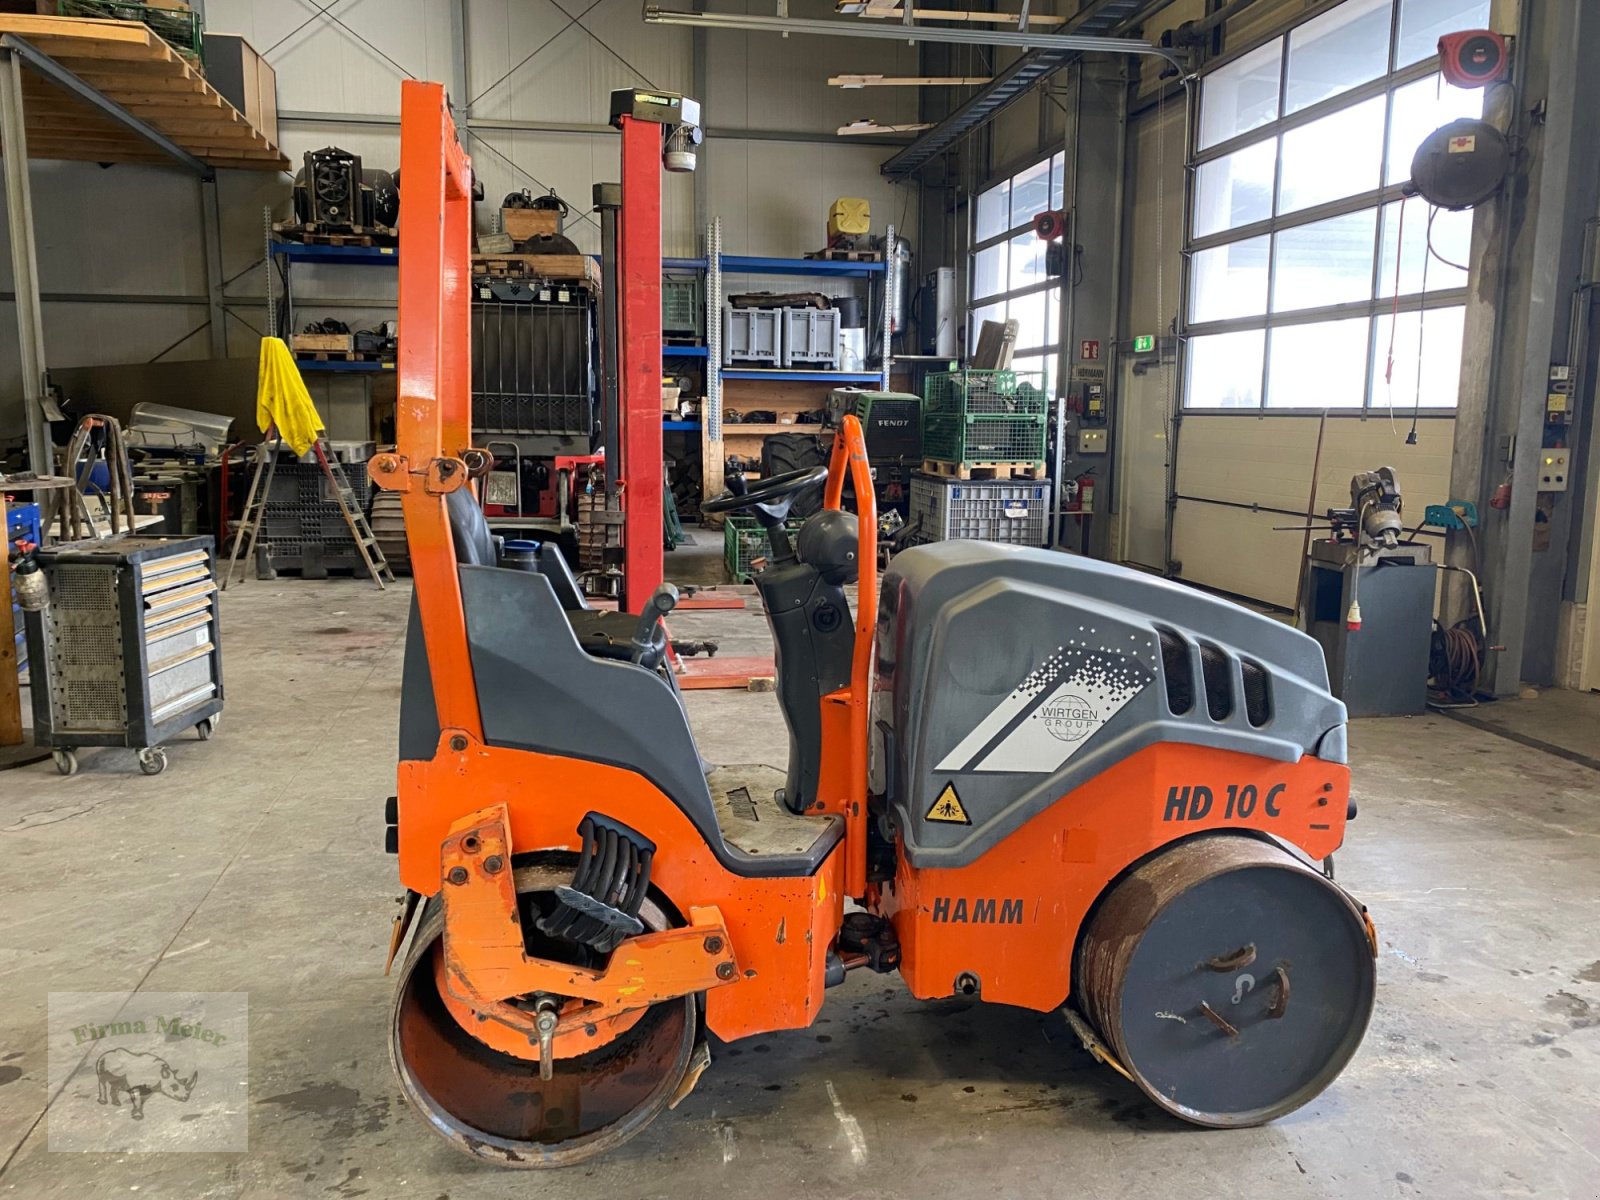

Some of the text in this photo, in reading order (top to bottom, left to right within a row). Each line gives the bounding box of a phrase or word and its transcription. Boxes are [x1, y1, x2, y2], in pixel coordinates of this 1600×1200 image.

[878, 419, 910, 427] FENDT
[1041, 707, 1098, 720] WIRTGEN
[1044, 718, 1093, 729] GROUP
[1163, 783, 1287, 821] HD 10 C
[932, 897, 1024, 925] HAMM
